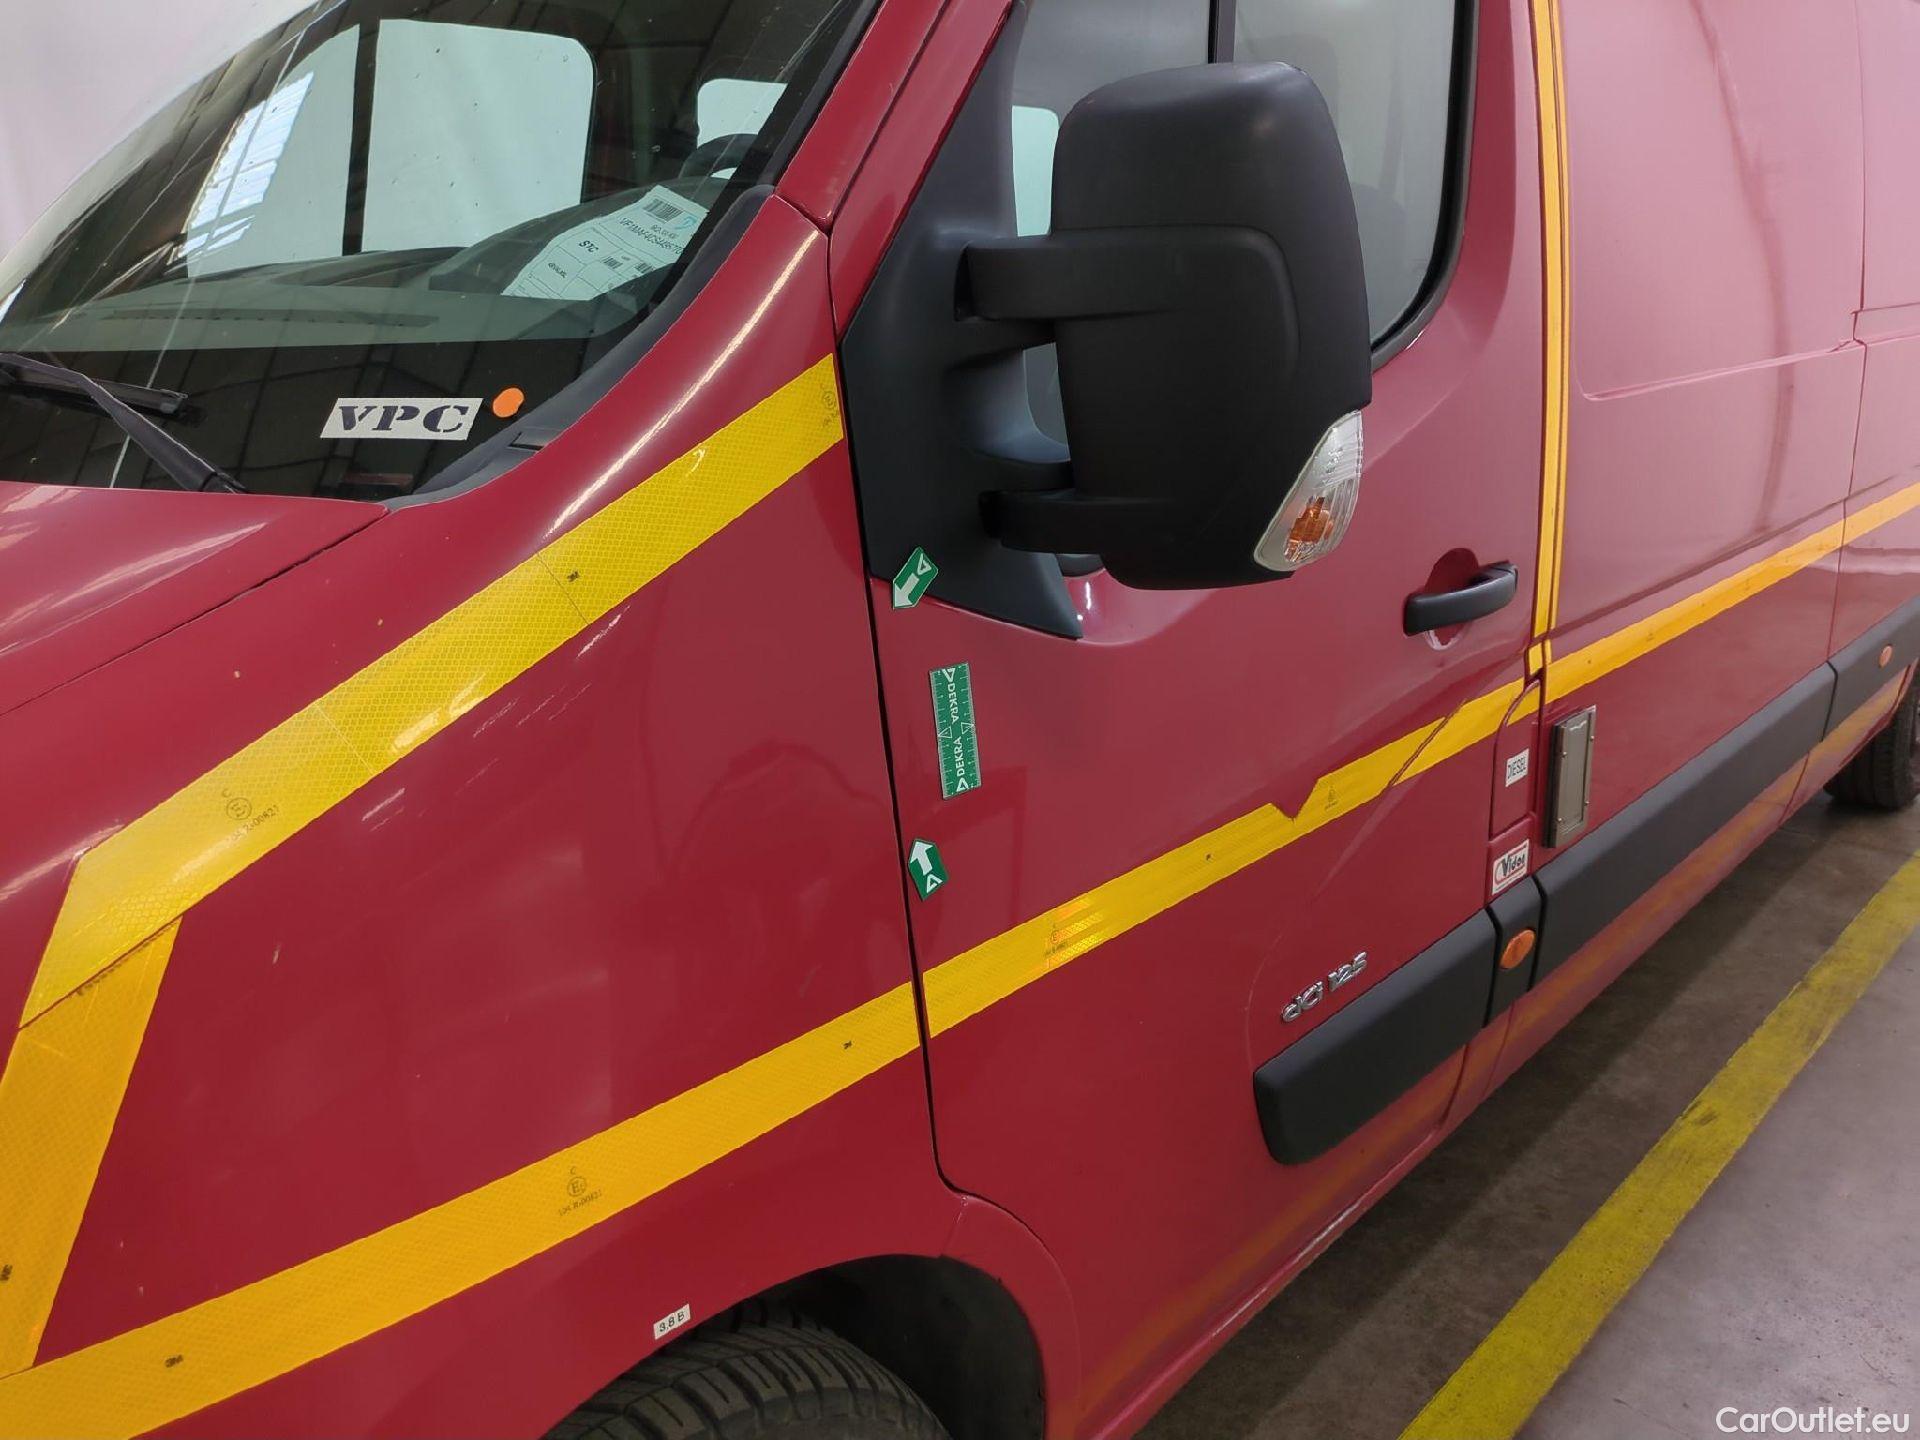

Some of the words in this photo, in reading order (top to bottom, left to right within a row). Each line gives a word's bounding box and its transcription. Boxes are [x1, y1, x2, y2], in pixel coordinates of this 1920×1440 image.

[578, 240, 599, 253] STC
[339, 405, 470, 433] VPC
[947, 682, 959, 724] DEKRA
[953, 736, 965, 777] DEKRA
[1507, 756, 1526, 779] DIESEL
[1327, 951, 1367, 992] 125
[677, 1311, 685, 1322] B
